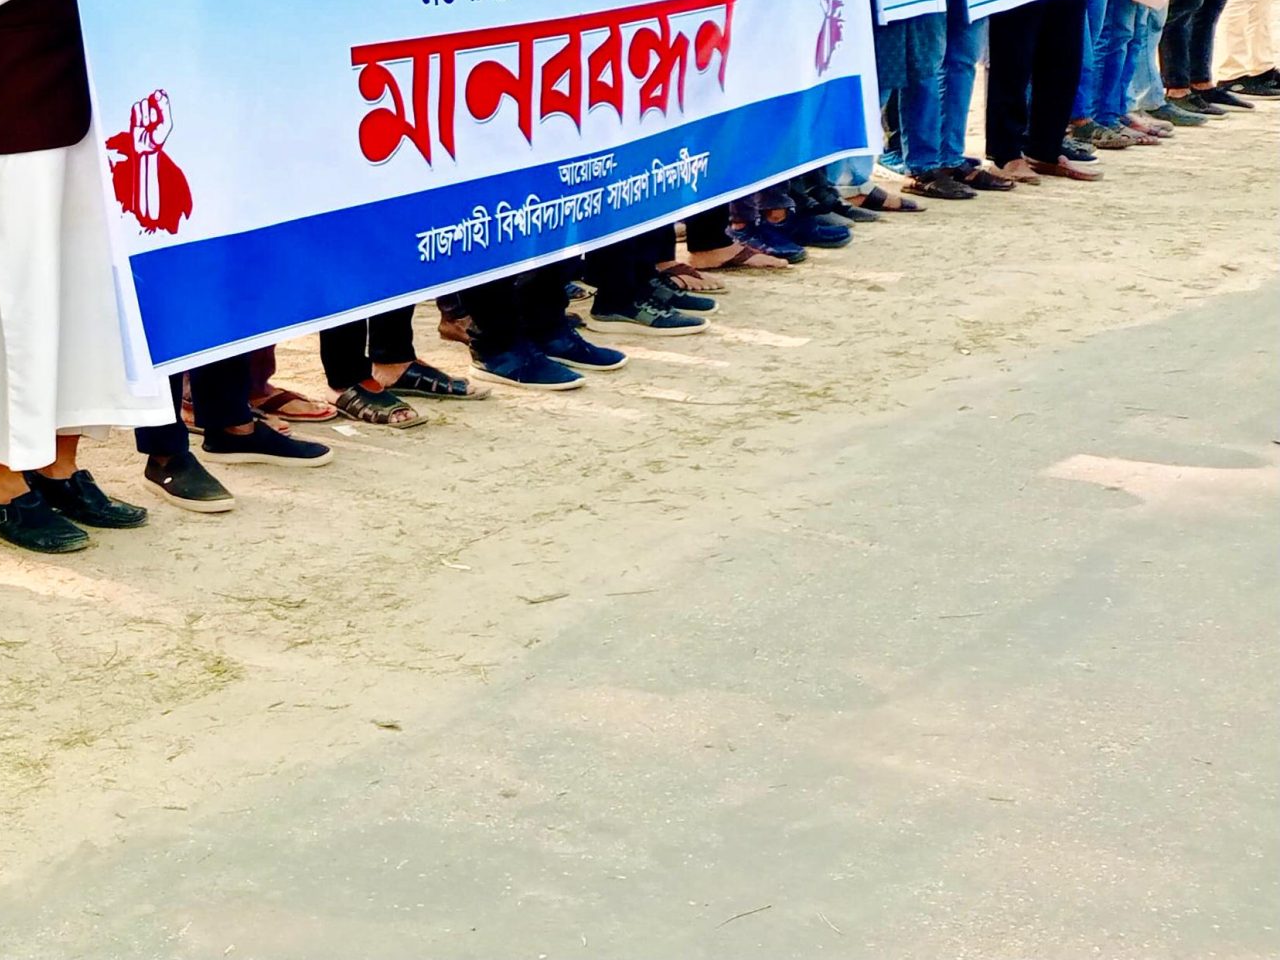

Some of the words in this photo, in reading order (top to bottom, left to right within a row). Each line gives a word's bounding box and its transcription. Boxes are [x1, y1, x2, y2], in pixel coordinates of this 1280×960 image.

[416, 205, 491, 262] রাজশাহী
[495, 187, 605, 243] বিশ্ববিদ্যালয়ের
[607, 170, 650, 210] সাধারণ
[651, 147, 710, 192] শিক্ষার্থীবৃন্দ
